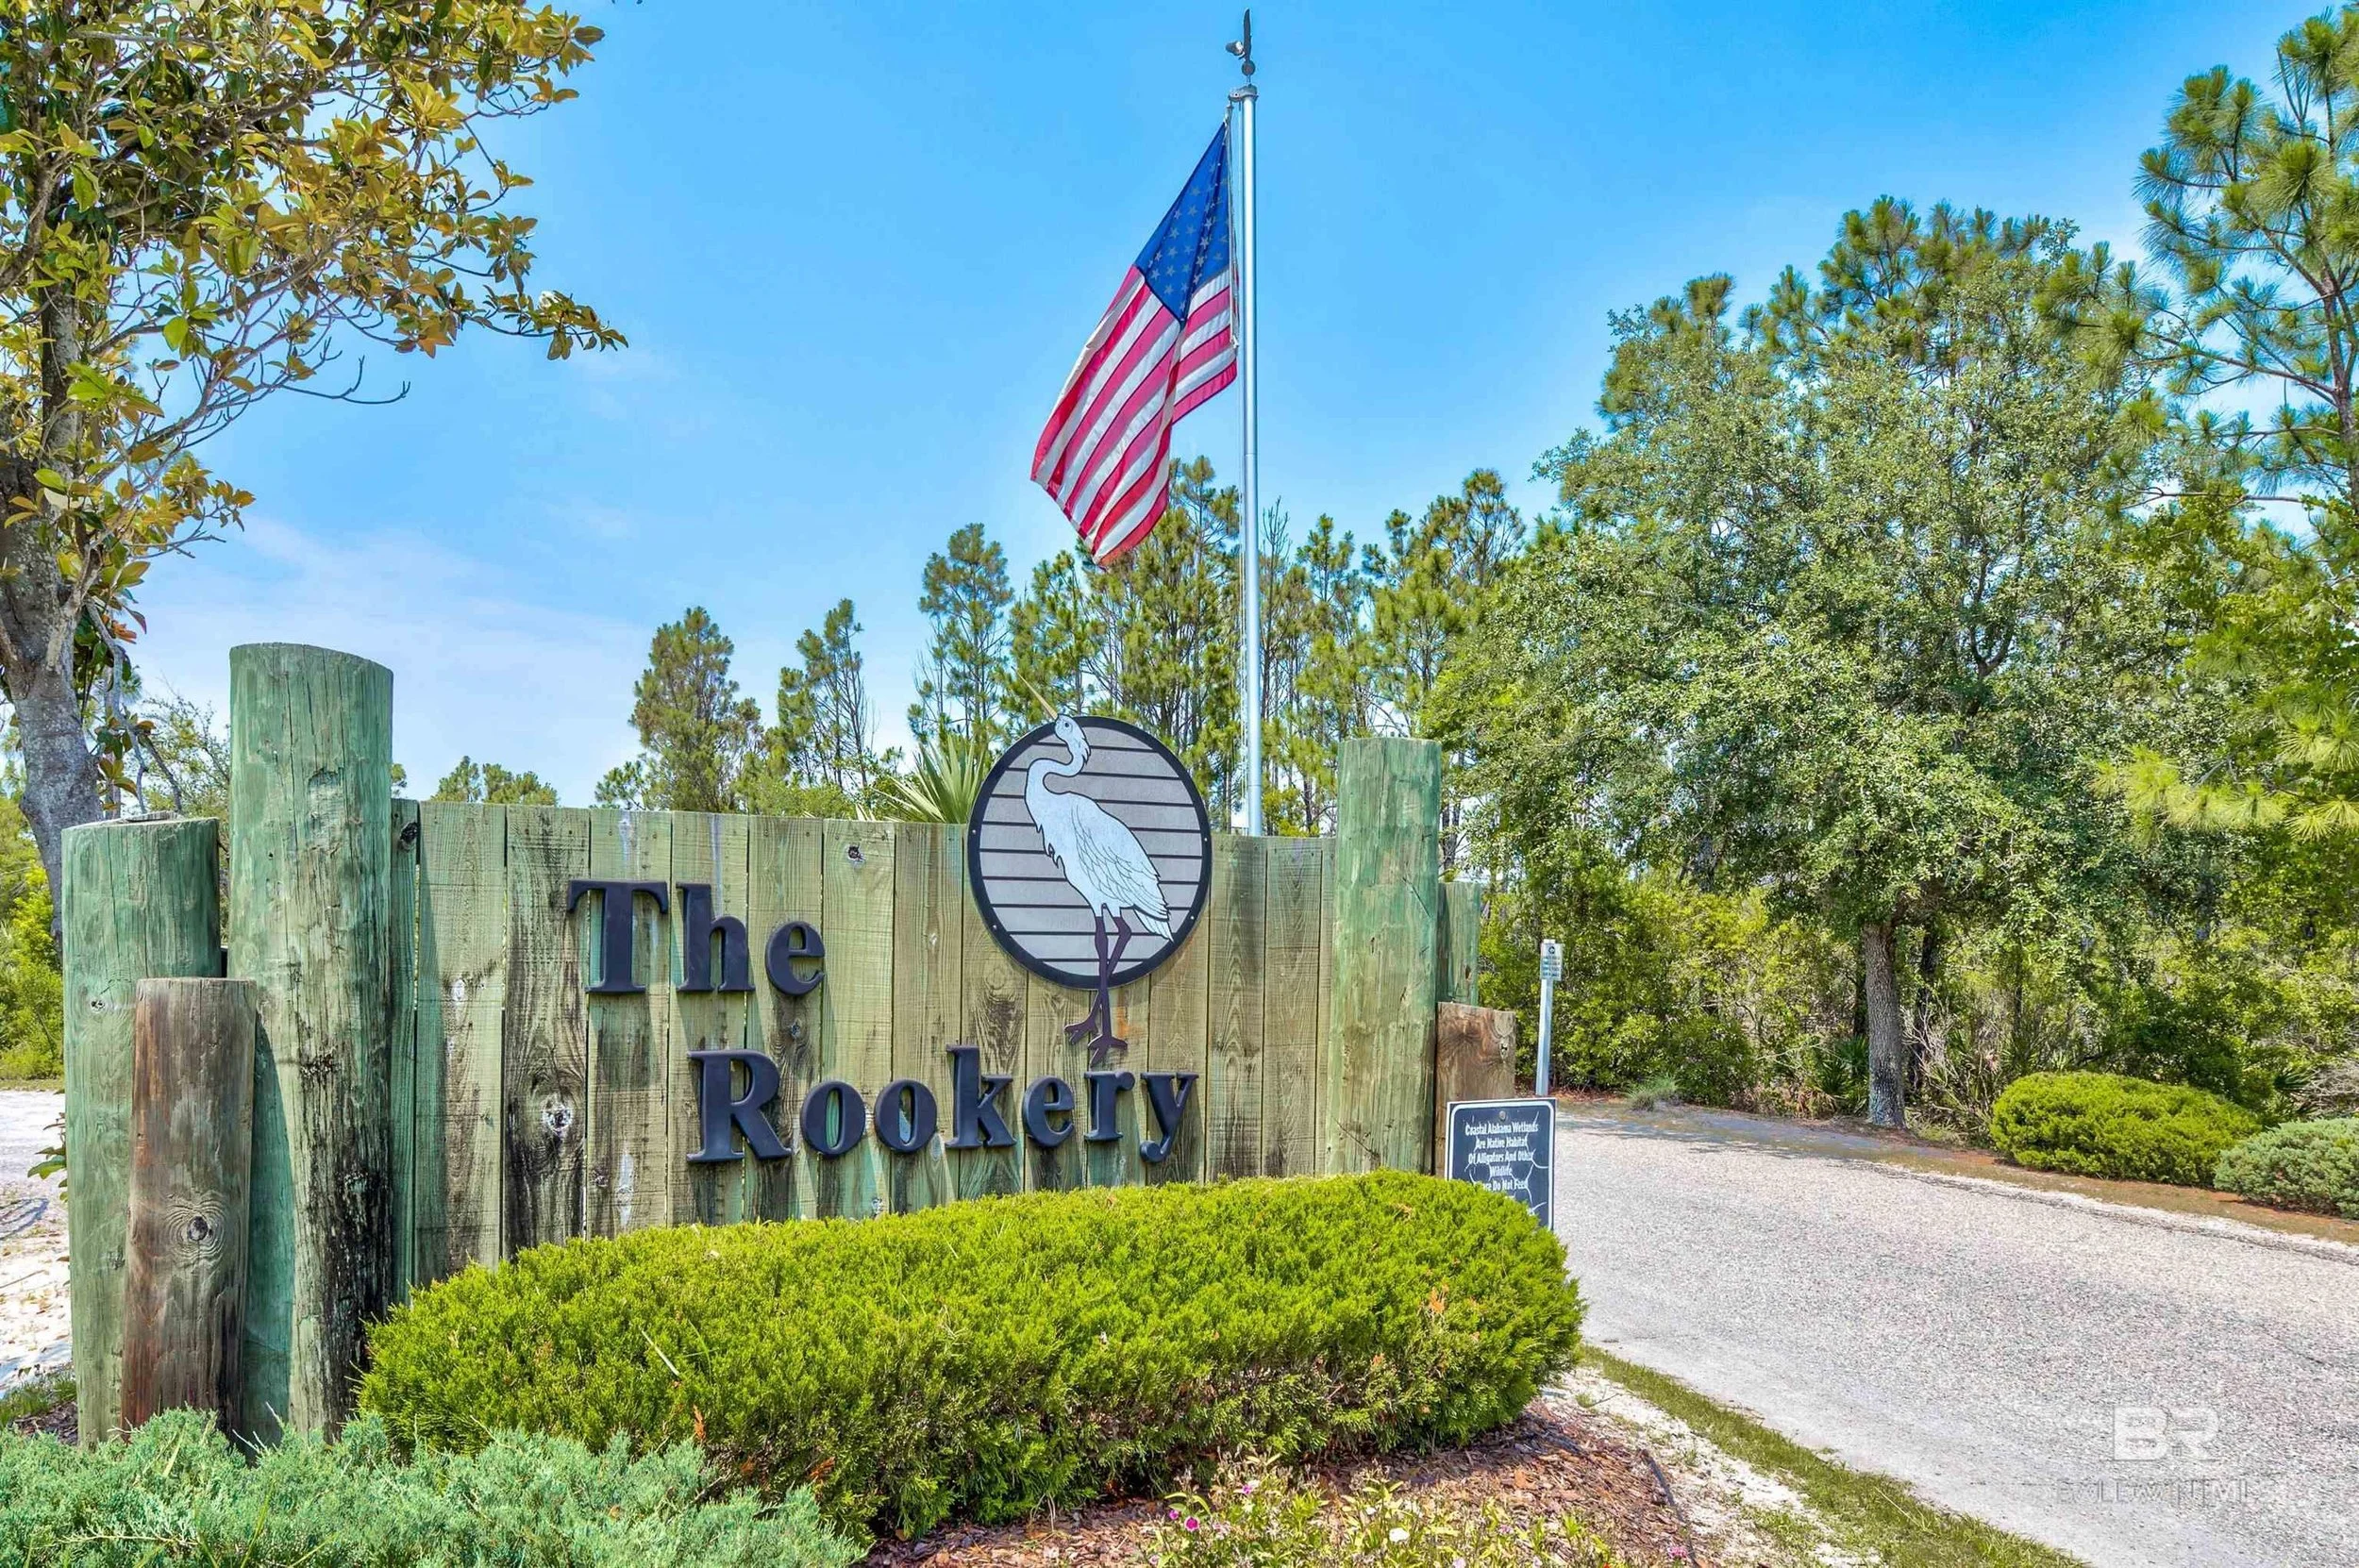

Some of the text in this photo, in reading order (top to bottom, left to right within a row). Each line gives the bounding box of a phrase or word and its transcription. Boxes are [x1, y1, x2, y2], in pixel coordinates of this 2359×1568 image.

[566, 879, 826, 995] The
[686, 1043, 1199, 1164] Rookery
[1465, 1122, 1539, 1136] Coastal Alabama Wetlands
[1475, 1136, 1527, 1149] Are Native Habitat
[1468, 1150, 1533, 1165] Of Alligators And Other
[1490, 1165, 1513, 1177] Wildlife
[1492, 1180, 1501, 1191] Do
[1501, 1179, 1513, 1191] Not
[1514, 1178, 1528, 1190] Feed
